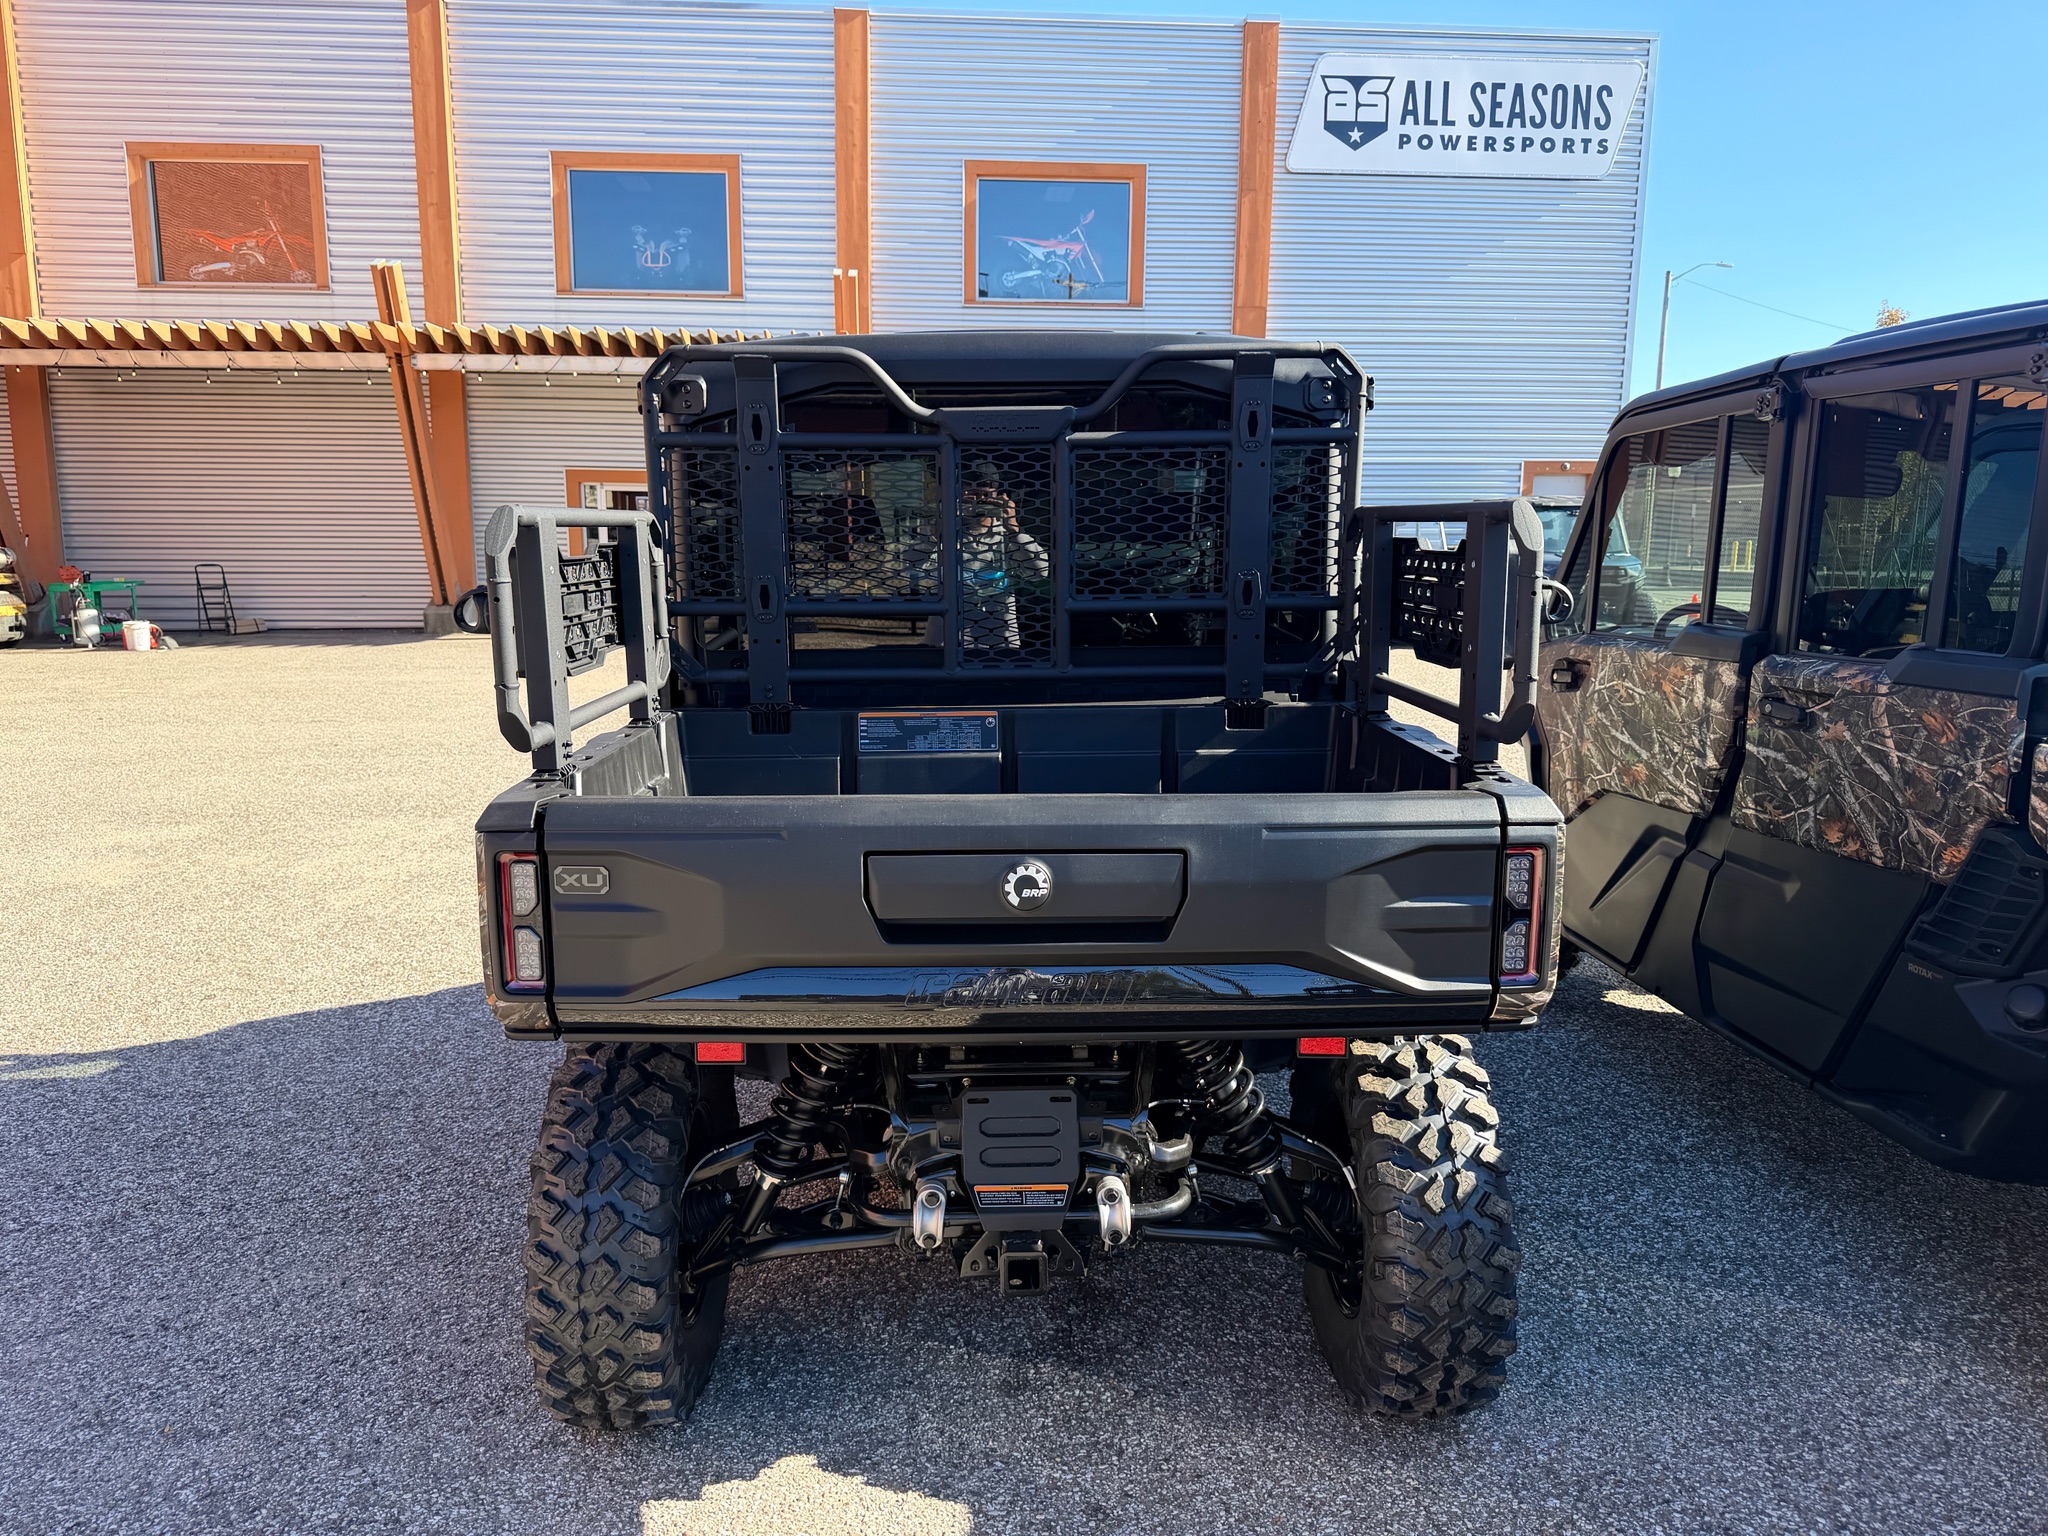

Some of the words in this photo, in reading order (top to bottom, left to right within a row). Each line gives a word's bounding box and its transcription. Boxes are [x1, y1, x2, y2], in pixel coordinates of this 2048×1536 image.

[1400, 80, 1457, 127] ALL
[1468, 81, 1614, 131] SEASONS
[1398, 133, 1610, 155] POWERSPORTS
[560, 873, 603, 887] XU
[1021, 888, 1048, 898] BRP
[1907, 962, 1933, 980] ROTAX
